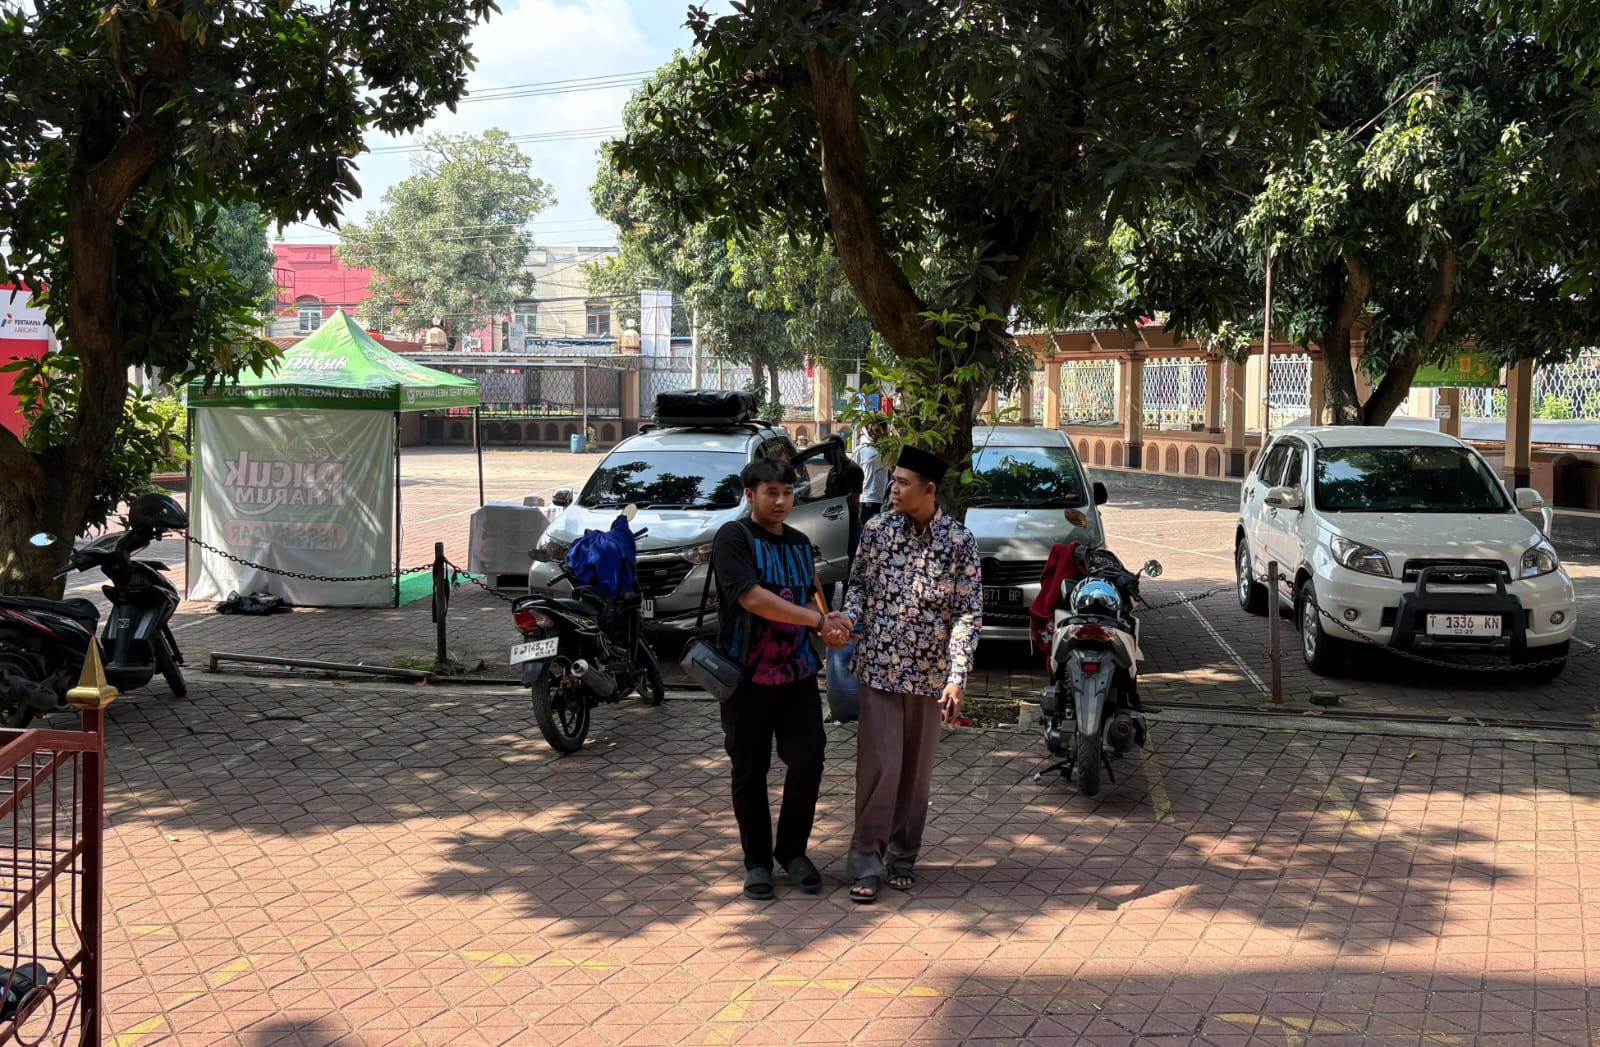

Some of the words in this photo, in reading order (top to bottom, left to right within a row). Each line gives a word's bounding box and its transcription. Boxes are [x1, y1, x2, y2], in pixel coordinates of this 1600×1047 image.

[222, 387, 254, 398] PUCUK
[257, 387, 296, 398] TEHNYA
[298, 388, 340, 399] RENDAH
[341, 389, 390, 400] GULANYA
[1430, 616, 1436, 628] T
[1445, 616, 1474, 629] 1336
[1484, 616, 1500, 630] KN
